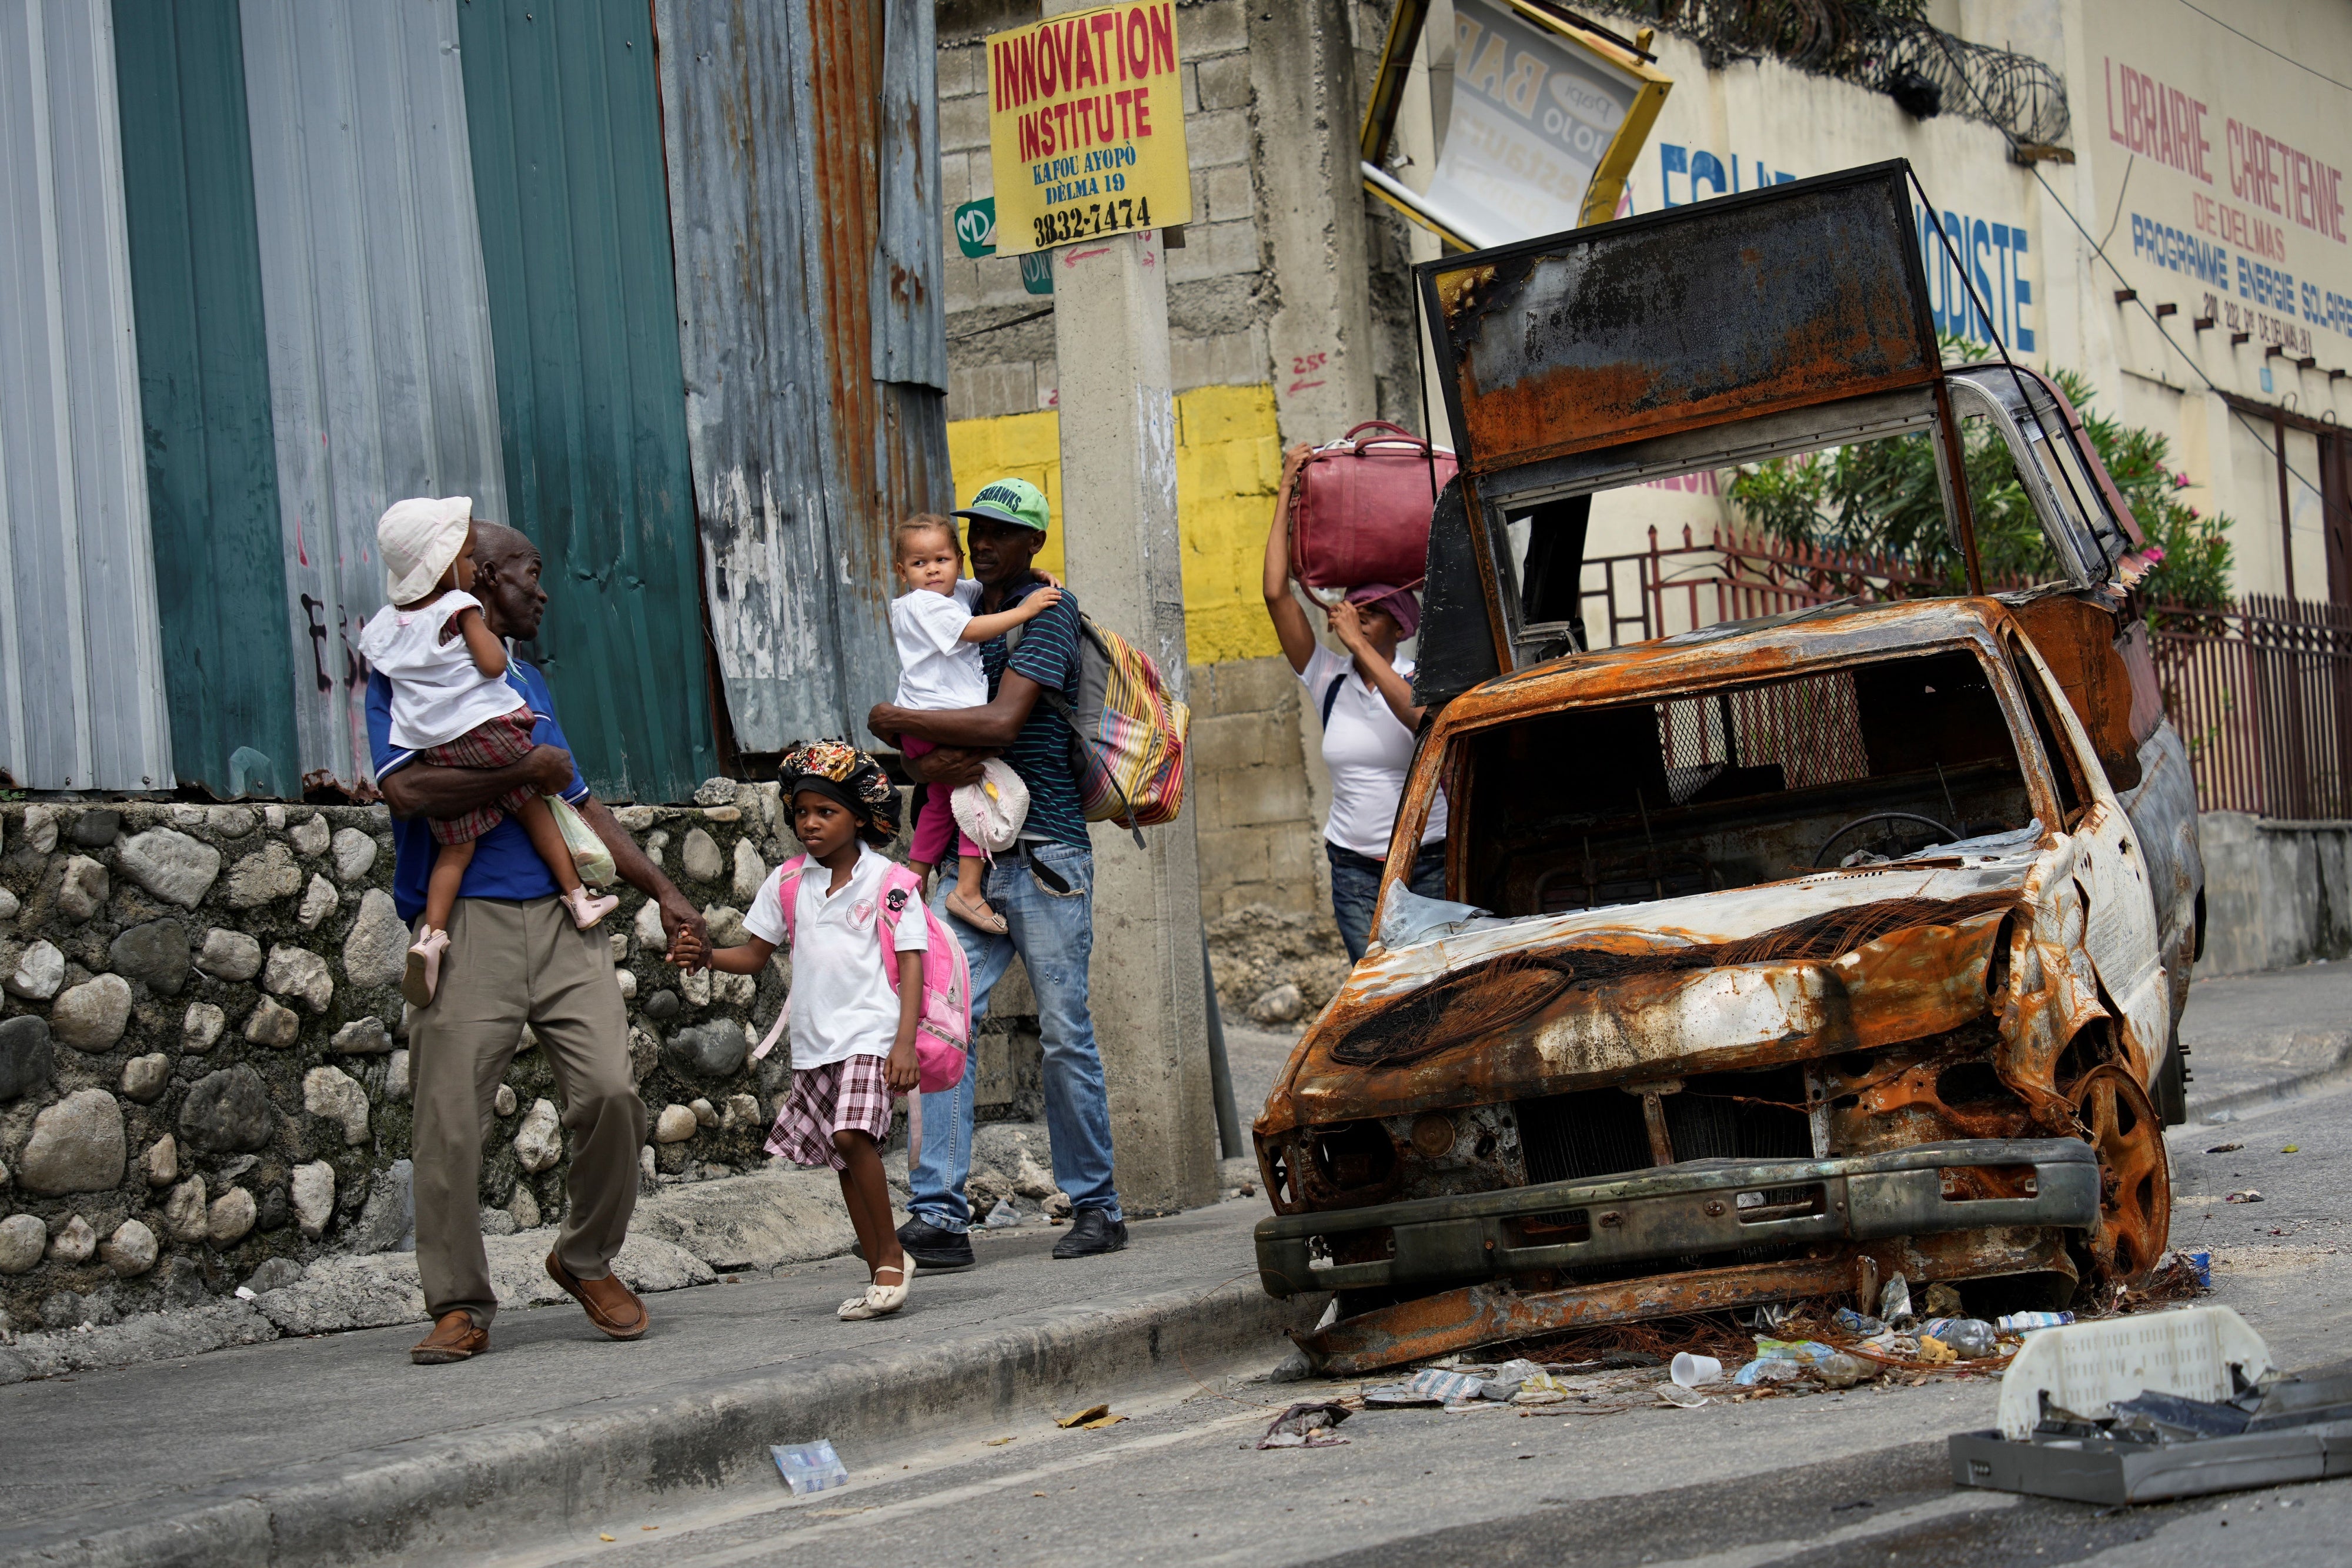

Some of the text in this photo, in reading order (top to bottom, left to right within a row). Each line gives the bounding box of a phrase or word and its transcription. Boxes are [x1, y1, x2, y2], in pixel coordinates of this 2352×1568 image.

[994, 2, 1175, 113] INNOVATION
[1018, 87, 1152, 163] INSTITUTE
[2104, 55, 2347, 245] LIBRAIRIE CHRETIENNE
[1033, 141, 1137, 186] KAFOU AYOPÒ
[1045, 173, 1125, 205] DÈLMA 19
[1033, 196, 1151, 248] 3832-7474
[2193, 191, 2286, 264] DE DELMAS
[2132, 211, 2229, 292] PROGRAMME
[2237, 255, 2296, 316] ENERGIE
